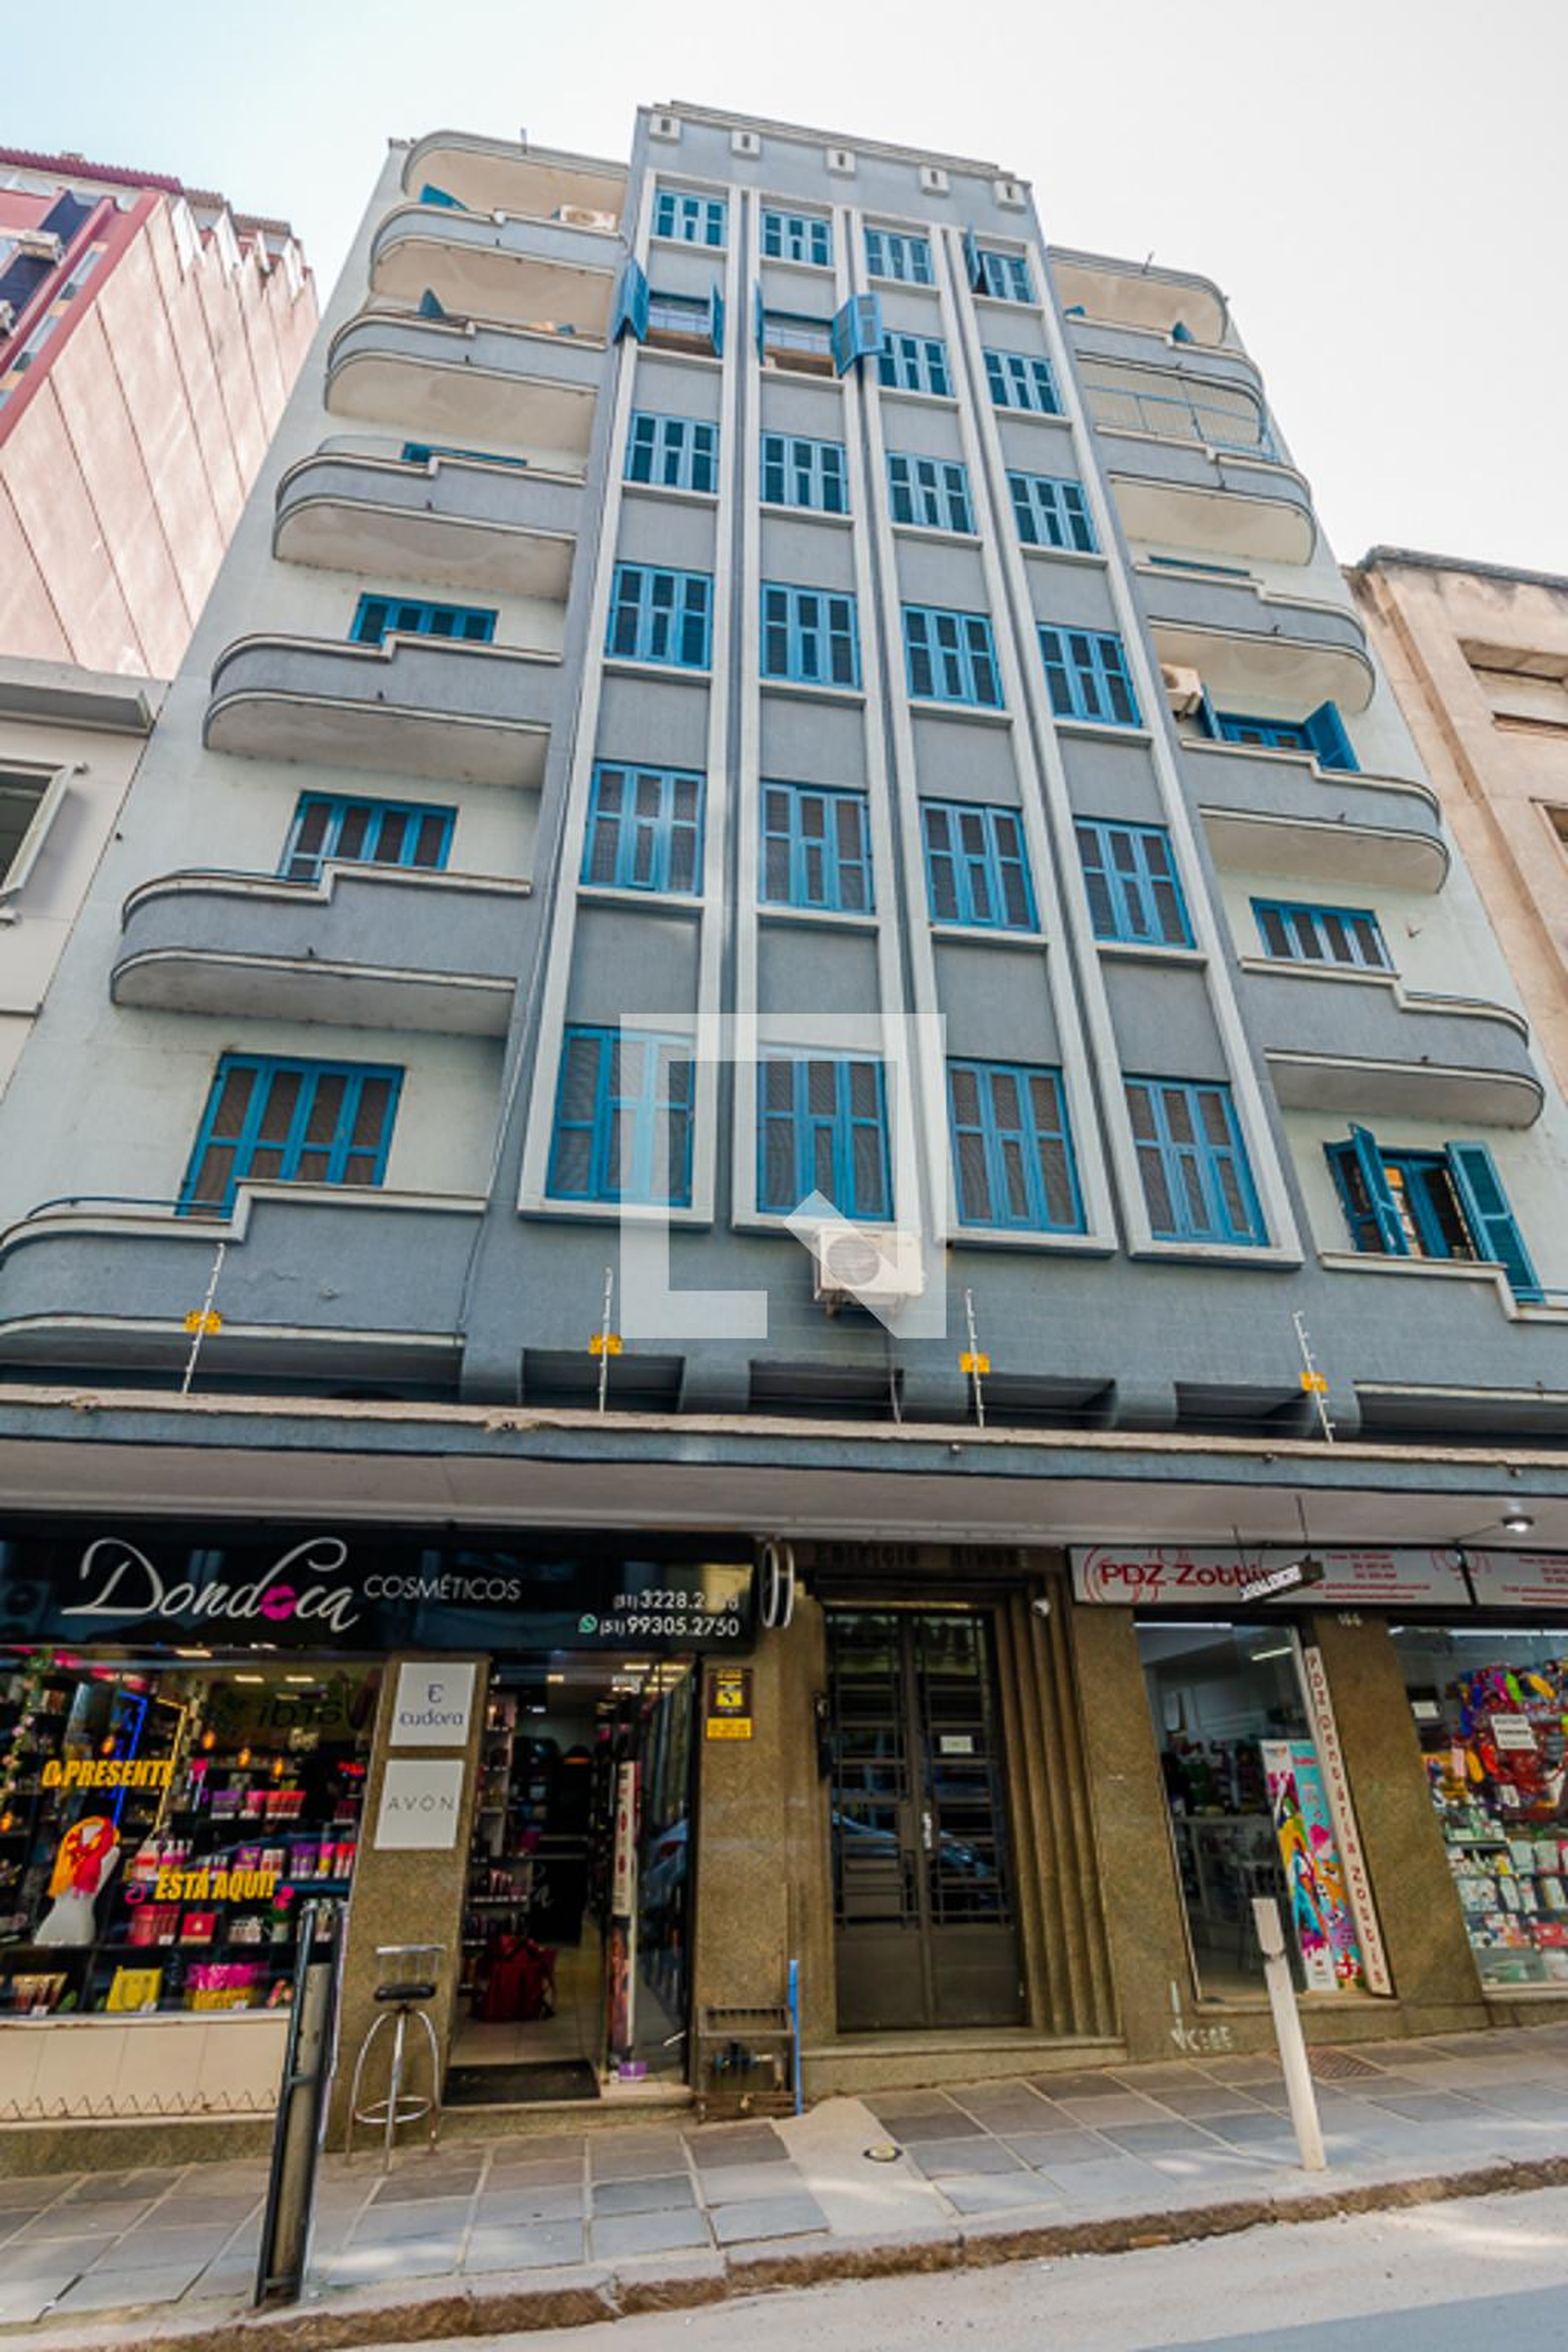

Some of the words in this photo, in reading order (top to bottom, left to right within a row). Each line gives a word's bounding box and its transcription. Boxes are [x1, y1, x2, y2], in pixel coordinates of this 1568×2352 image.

[1101, 1563, 1166, 1586] PDZ
[363, 1573, 521, 1600] COSMÉTICOS
[399, 1708, 464, 1726] eudora
[388, 1794, 454, 1812] AVON
